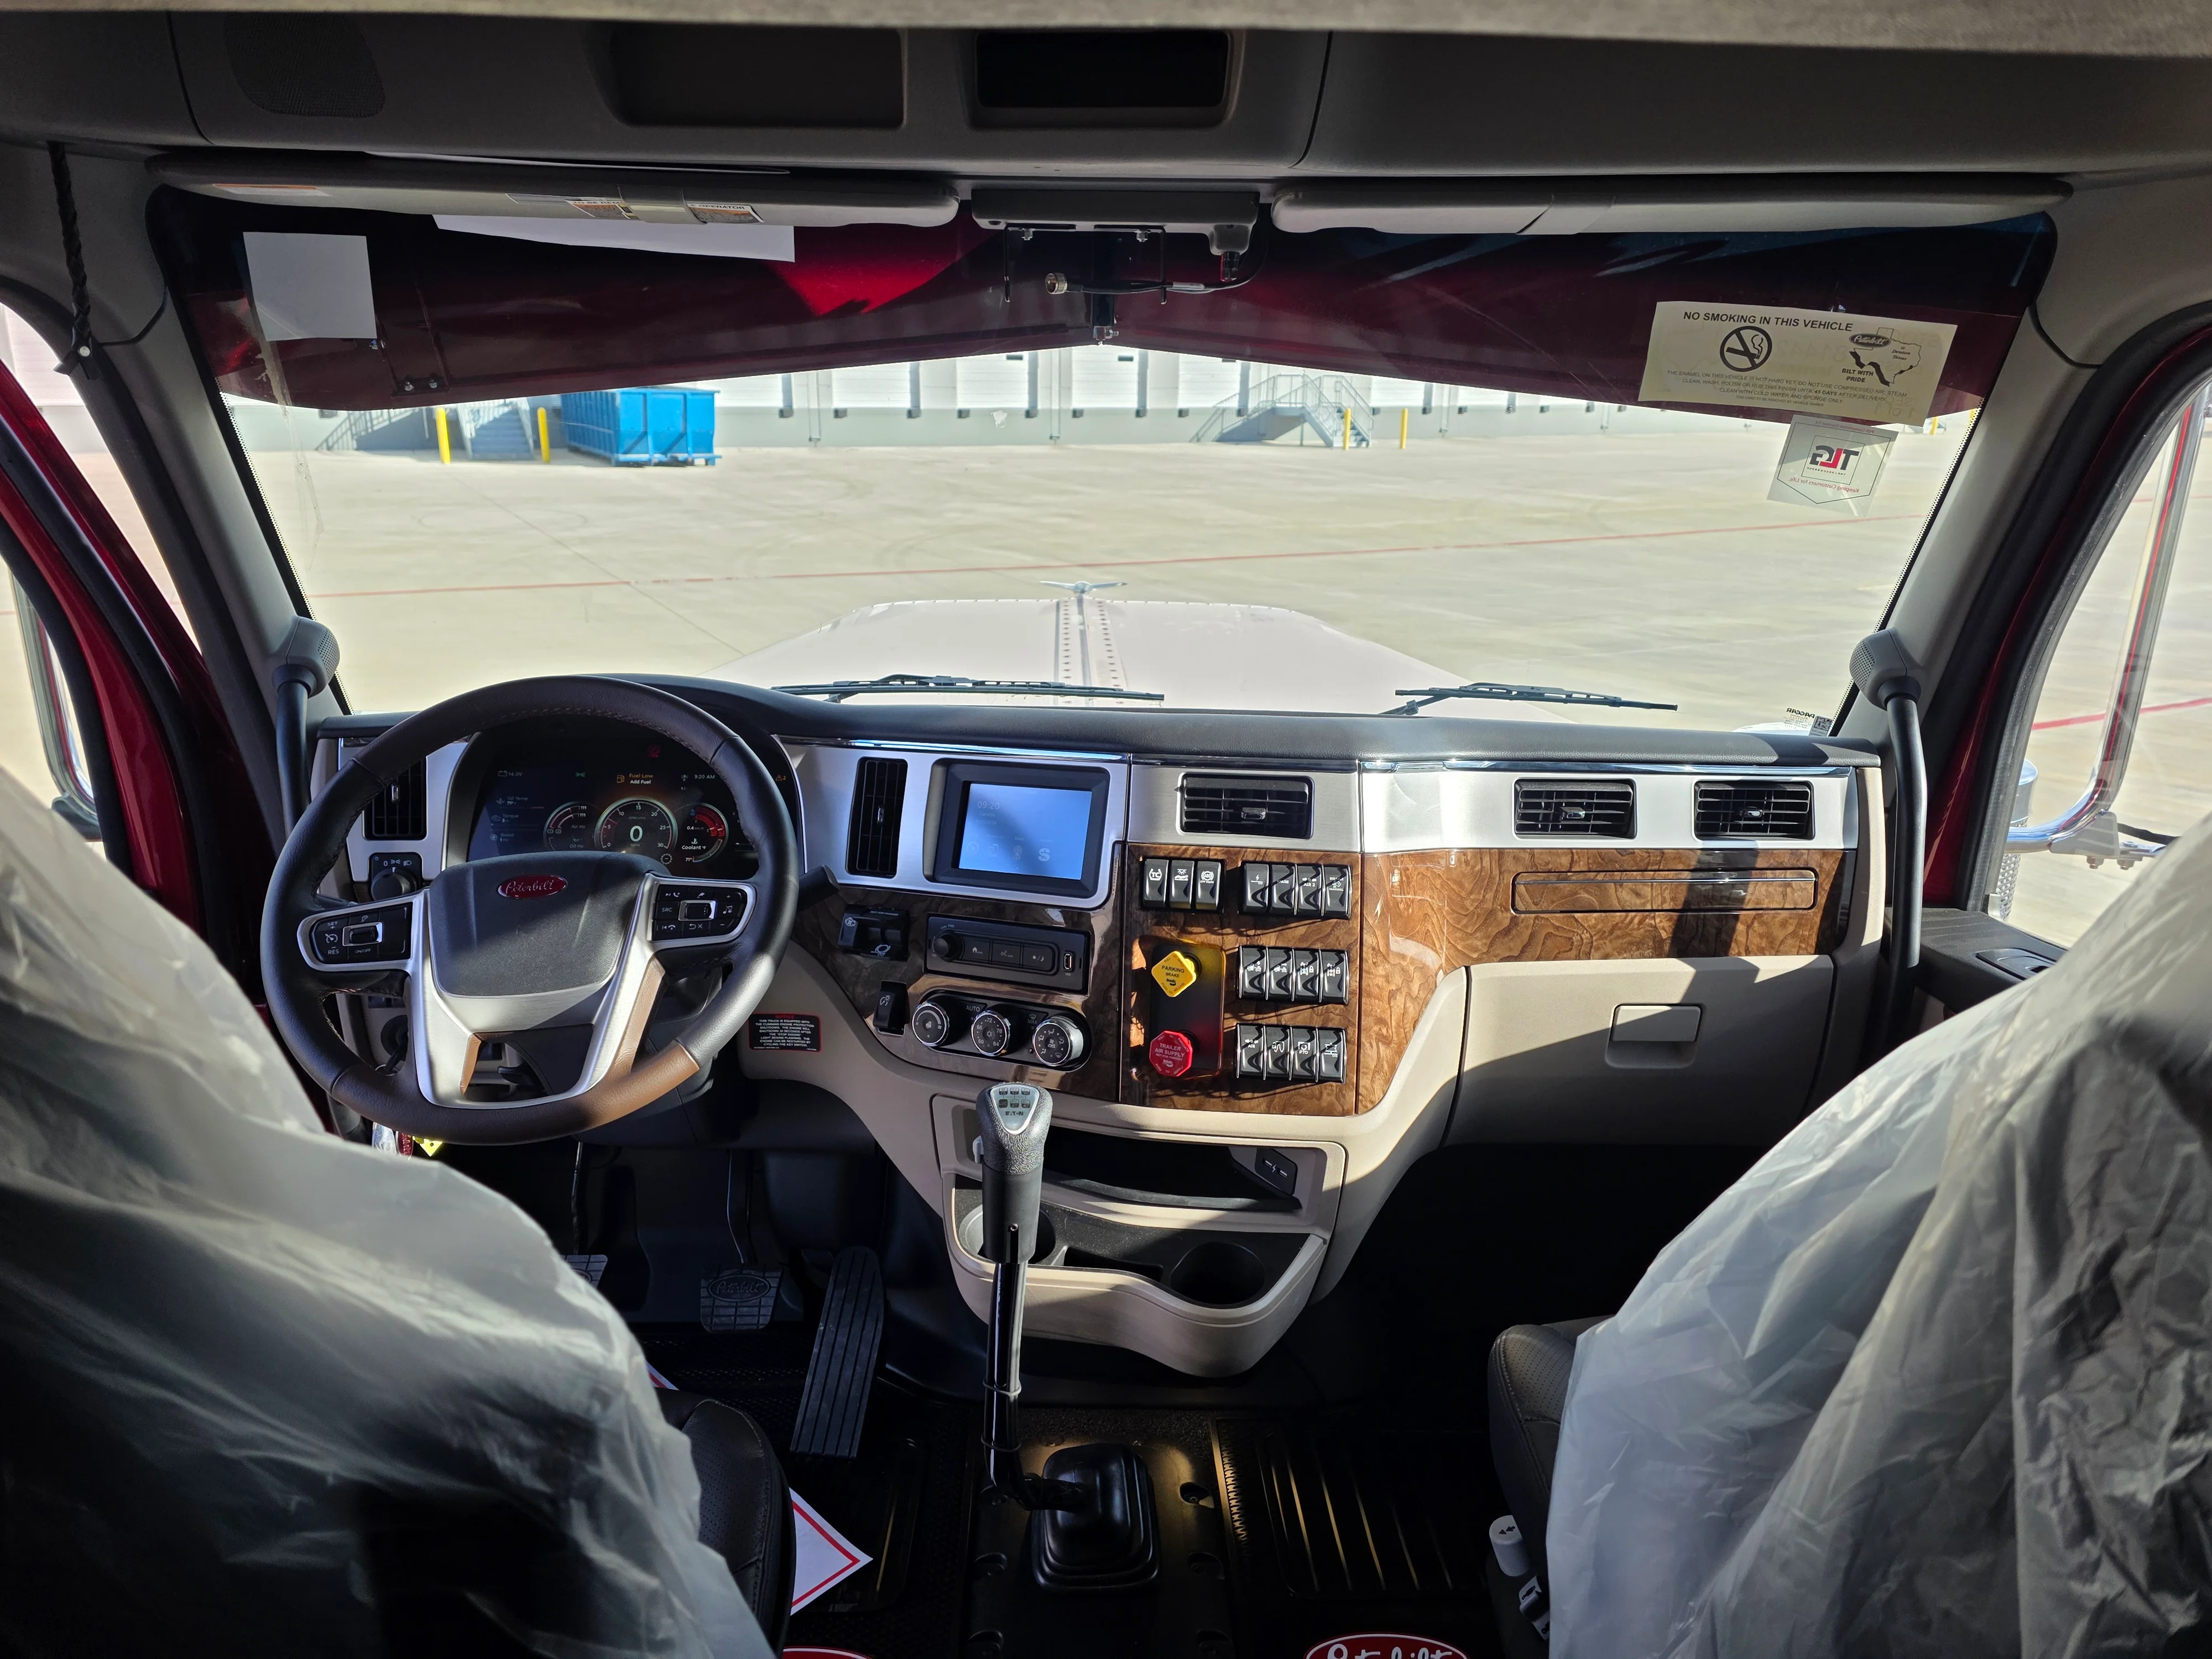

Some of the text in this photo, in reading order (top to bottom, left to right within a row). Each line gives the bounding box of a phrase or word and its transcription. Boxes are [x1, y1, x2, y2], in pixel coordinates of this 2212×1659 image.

[1683, 311, 1853, 331] NO SMOKING IN THIS VEHICLE
[1854, 335, 1888, 345] Peterbilt
[1833, 384, 1874, 394] COMPRESSED
[1858, 394, 1887, 402] DELIVERY.
[977, 801, 1000, 810] 09:20
[630, 826, 643, 842] 0
[505, 880, 554, 894] Peterbilt
[1160, 1043, 1181, 1051] TRAILER
[717, 1281, 764, 1295] Peterbilt
